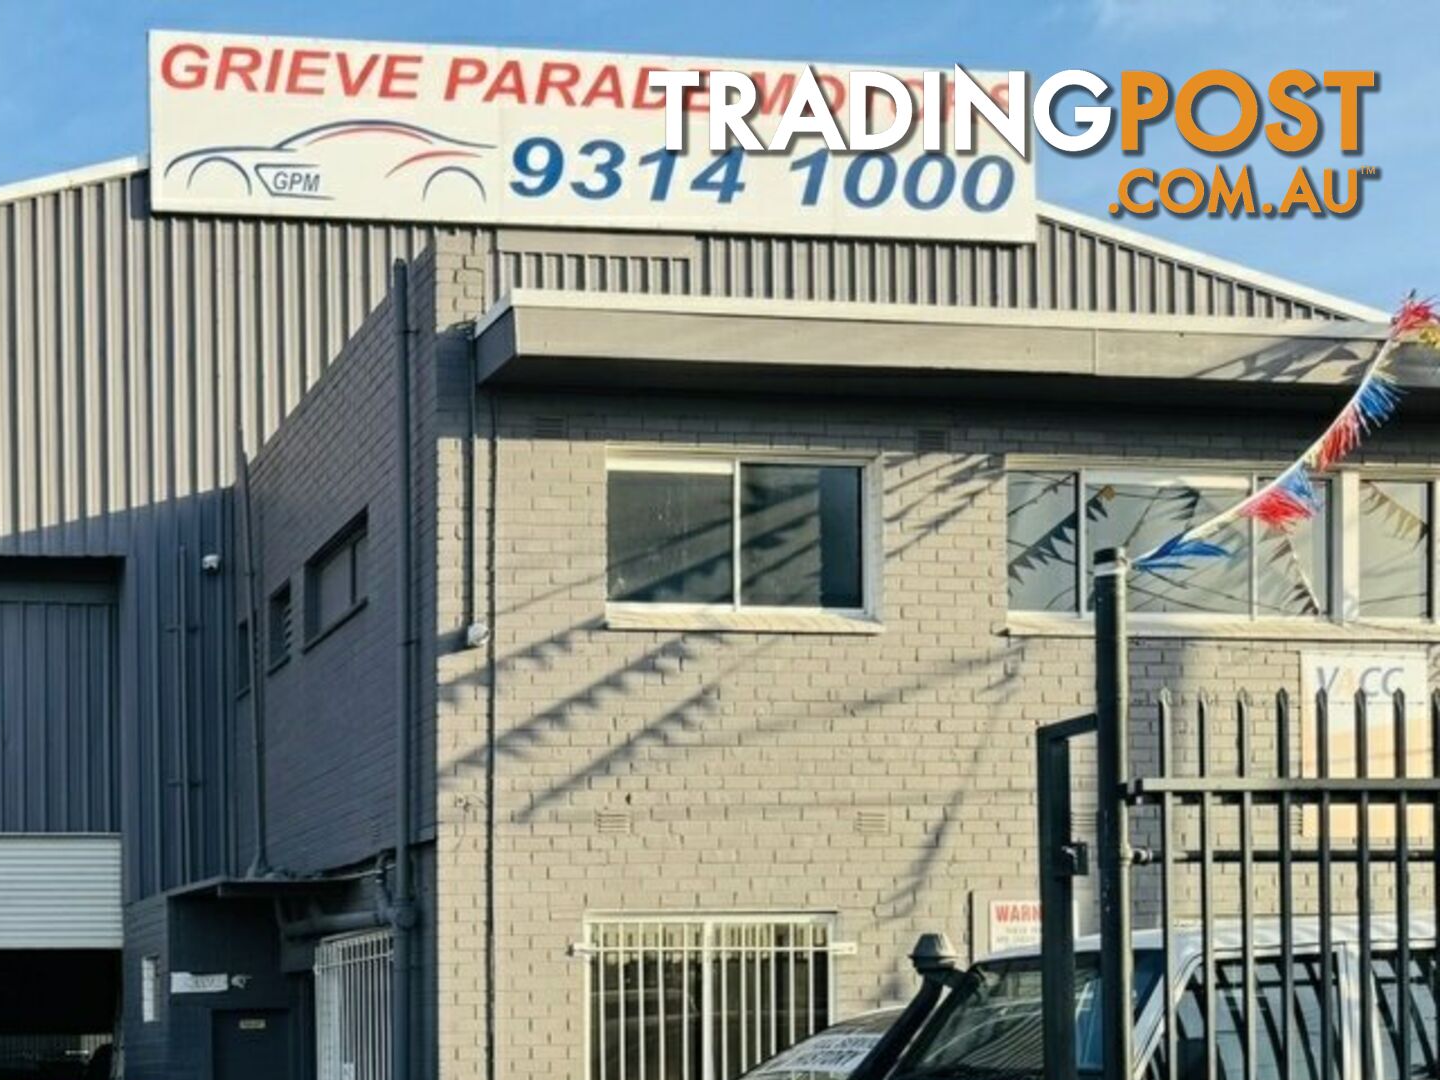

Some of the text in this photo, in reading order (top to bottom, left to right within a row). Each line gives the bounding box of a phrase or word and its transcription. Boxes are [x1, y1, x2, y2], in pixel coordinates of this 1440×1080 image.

[160, 43, 423, 99] GRIEVE
[272, 170, 321, 193] GPM
[509, 136, 1016, 213] 9314 1000
[995, 903, 1041, 922] WARN
